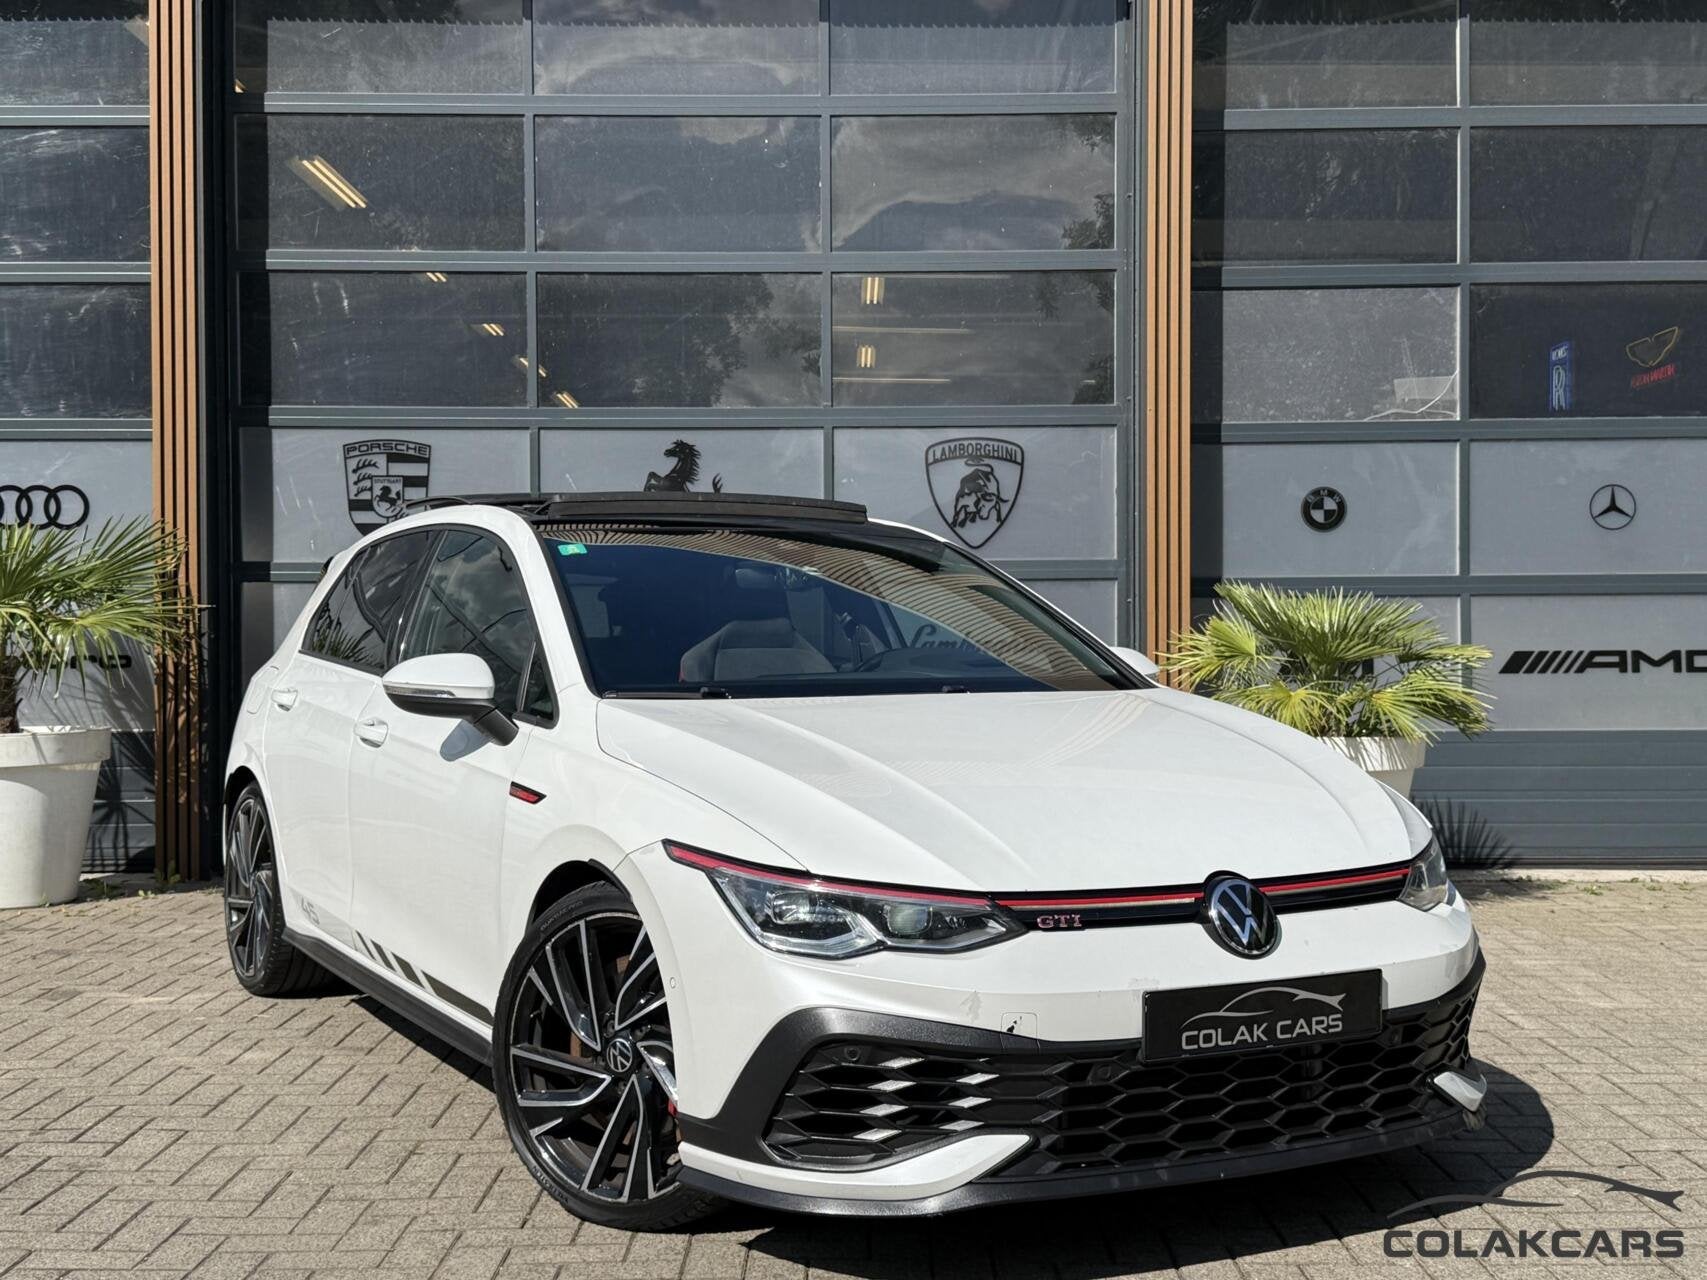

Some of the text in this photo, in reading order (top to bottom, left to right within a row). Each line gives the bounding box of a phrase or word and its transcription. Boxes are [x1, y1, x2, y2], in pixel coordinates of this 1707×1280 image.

[346, 442, 428, 456] PORSCHE
[932, 442, 1018, 461] LAMBORGHINI
[1036, 914, 1082, 929] GTI
[1181, 1014, 1343, 1050] COLAK CARS
